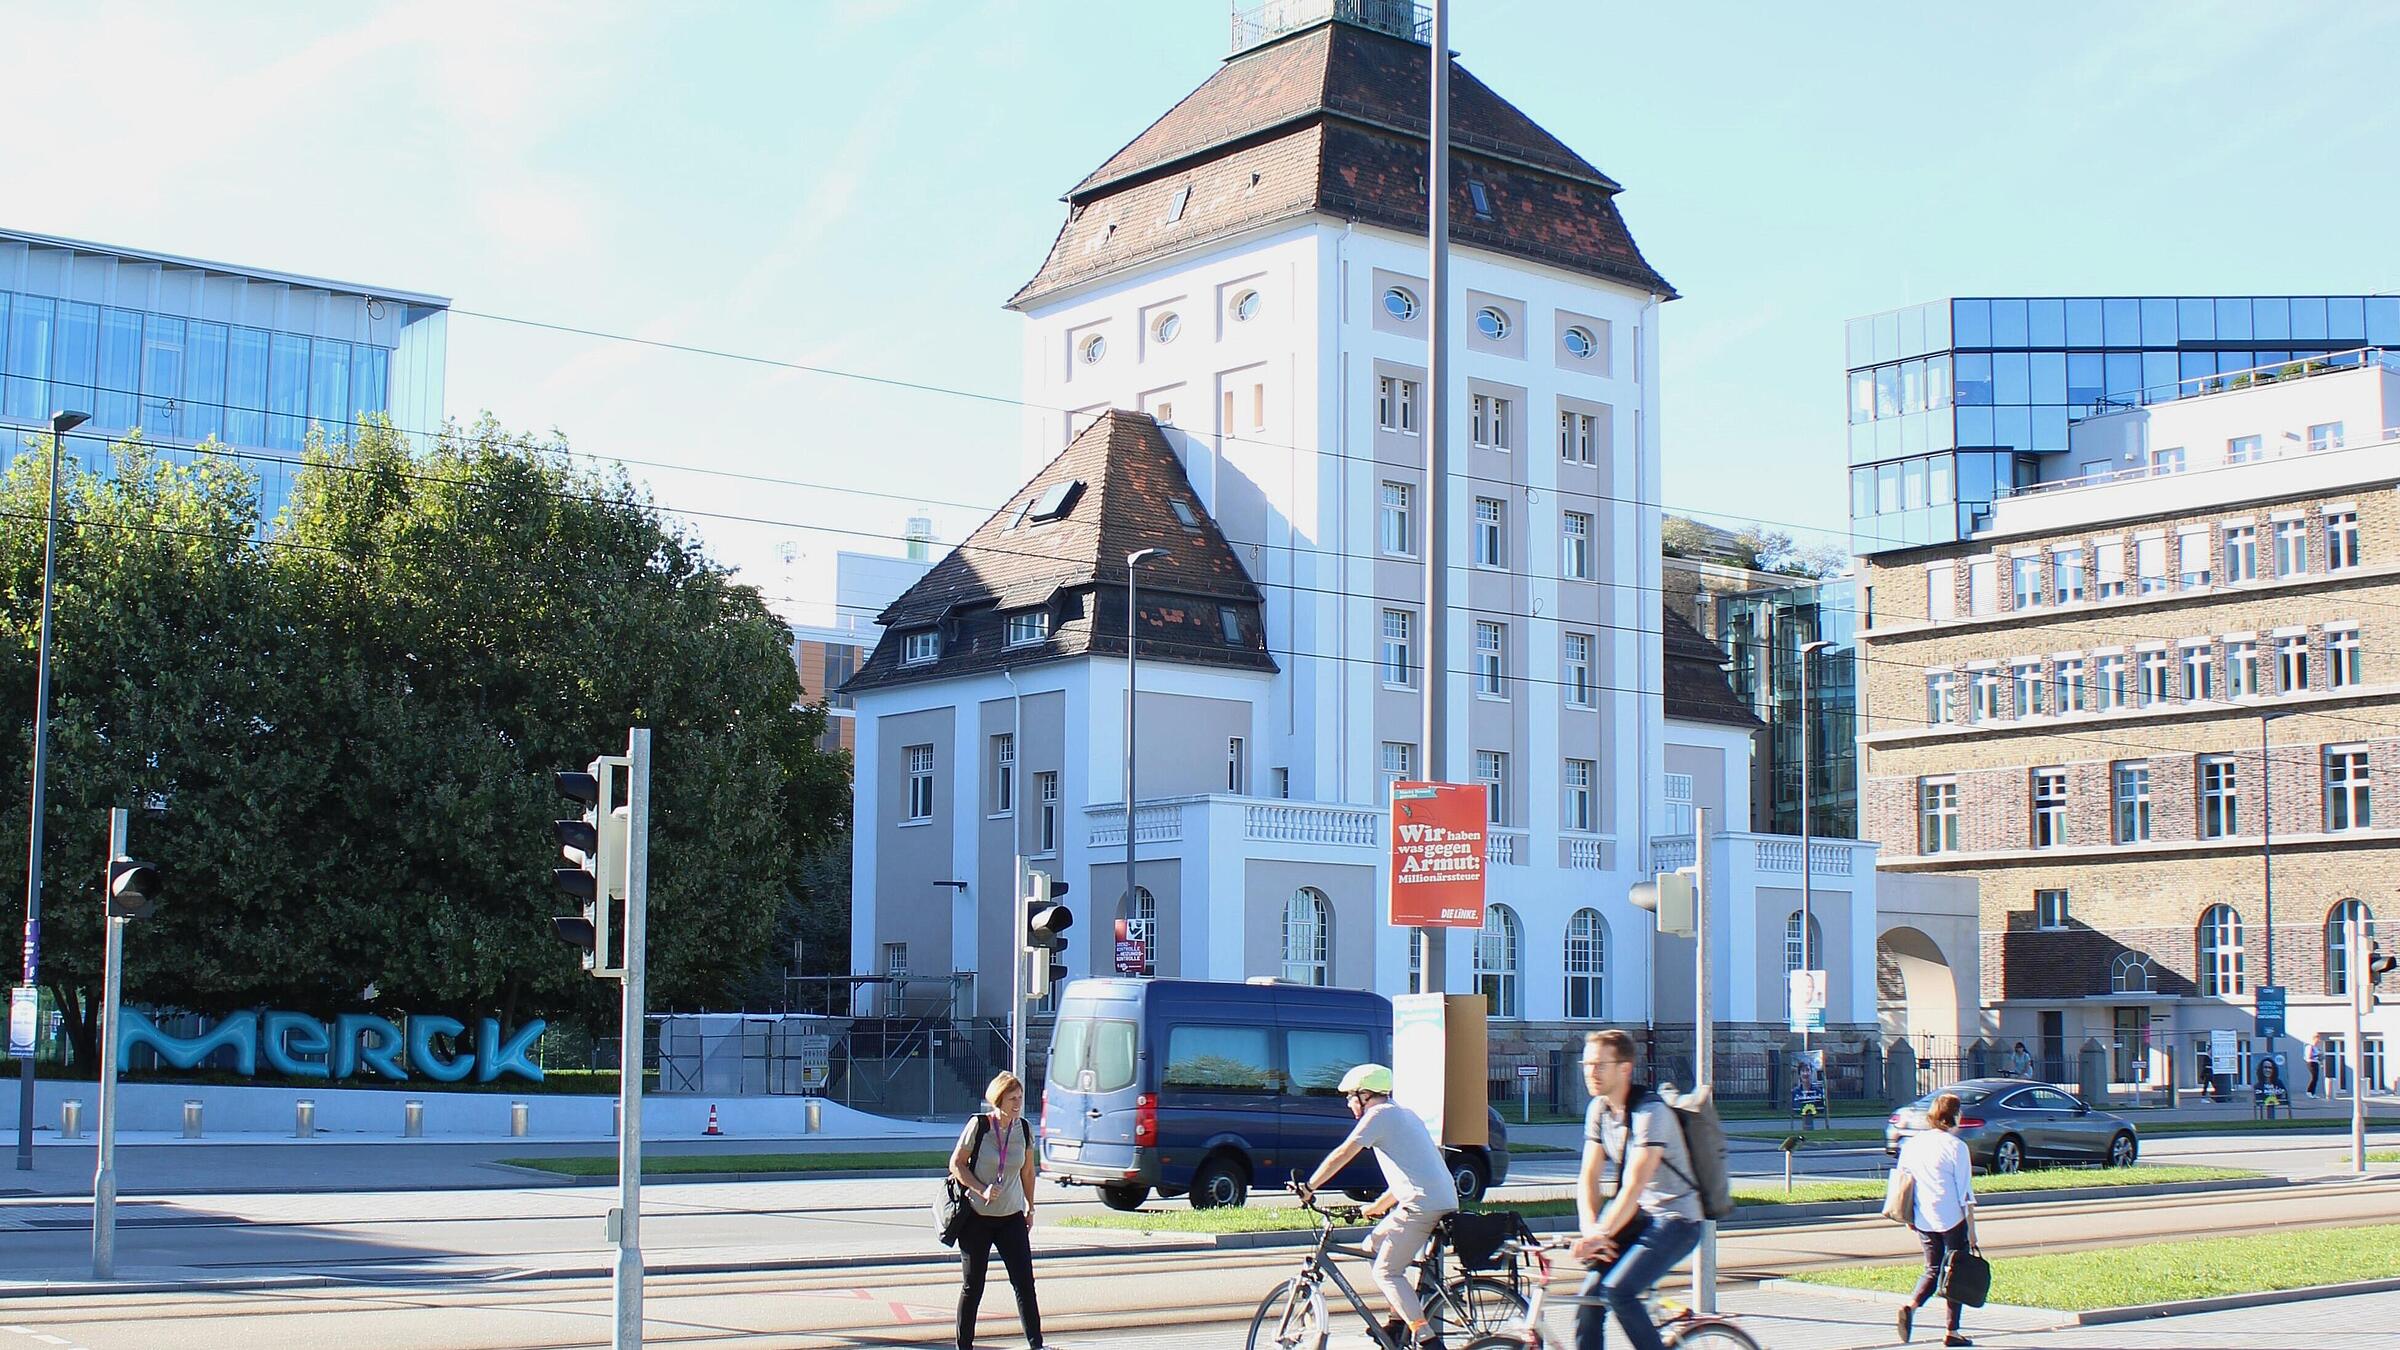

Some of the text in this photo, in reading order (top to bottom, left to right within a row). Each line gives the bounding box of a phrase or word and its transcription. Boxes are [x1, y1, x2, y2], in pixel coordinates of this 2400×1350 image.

[1398, 824, 1481, 843] Wir haben
[1398, 843, 1471, 858] was gegen
[1401, 855, 1480, 873] Armut:
[1398, 872, 1480, 884] Millionärssteuer
[1441, 908, 1455, 919] DIE
